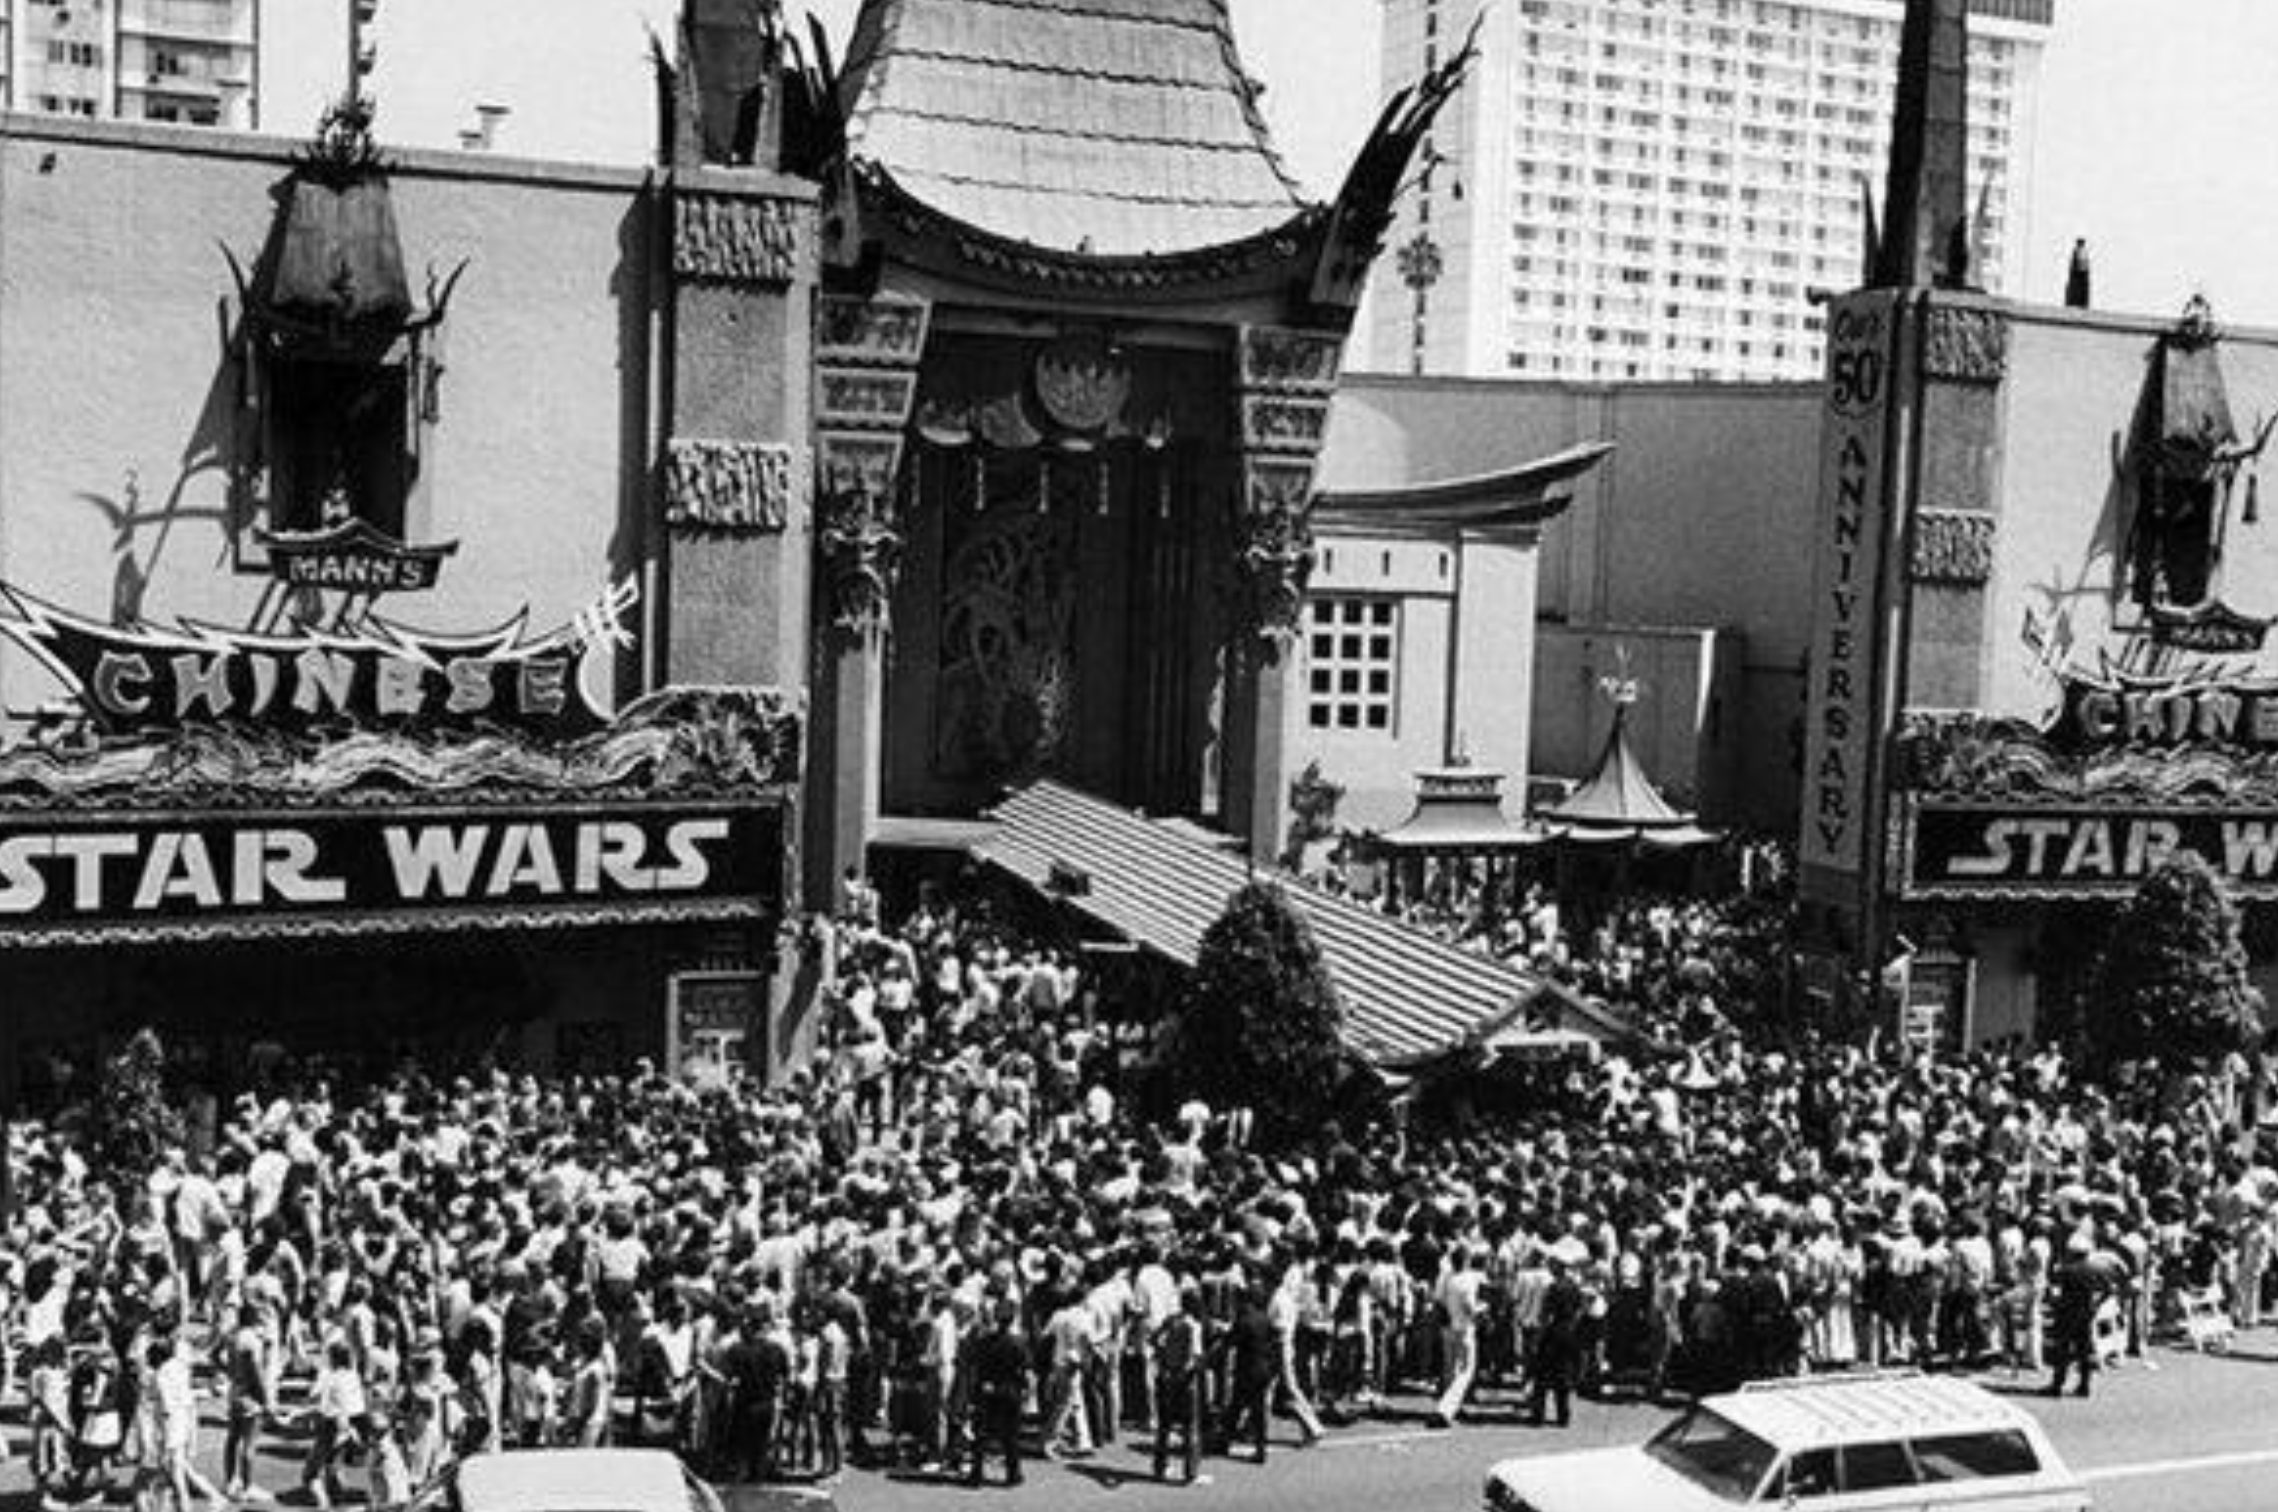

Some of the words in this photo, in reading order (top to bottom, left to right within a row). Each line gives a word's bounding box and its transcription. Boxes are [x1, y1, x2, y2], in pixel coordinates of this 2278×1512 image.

[1818, 433, 1867, 853] ANNIVERSARY
[94, 647, 569, 717] CHINESE
[383, 818, 731, 899] WARS
[1947, 820, 2181, 876] STAR
